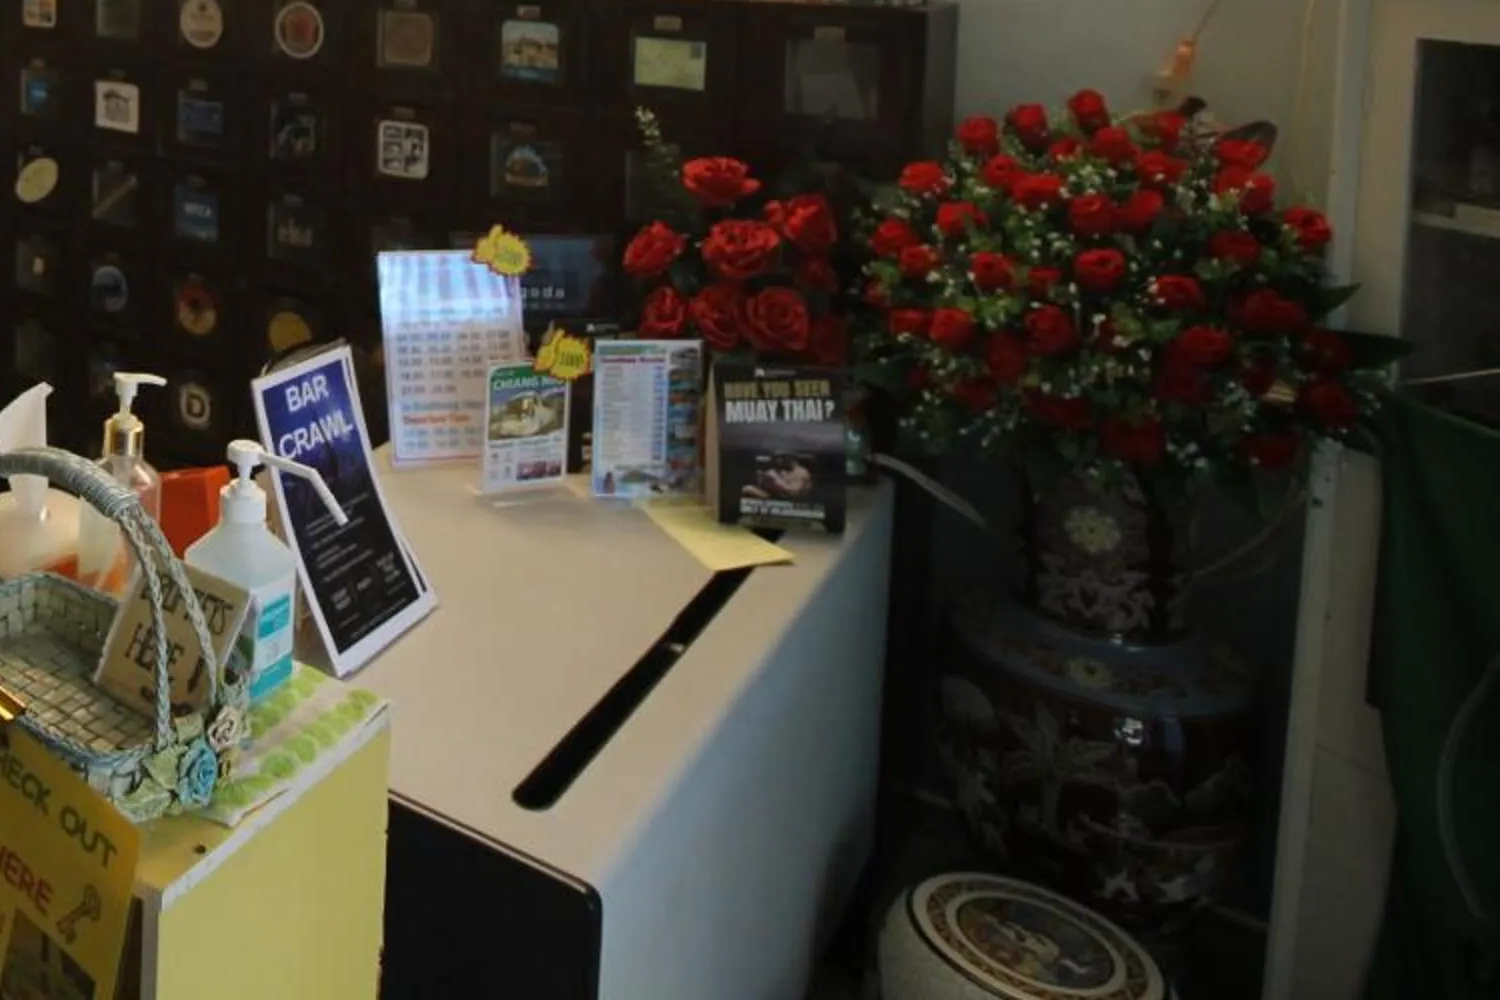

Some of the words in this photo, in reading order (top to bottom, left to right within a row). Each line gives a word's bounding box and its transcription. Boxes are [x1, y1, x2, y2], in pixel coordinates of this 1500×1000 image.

[520, 285, 565, 299] goda
[285, 374, 329, 412] BAR
[725, 399, 778, 423] MUAY
[781, 398, 836, 422] THAI?
[279, 411, 354, 459] CRAWL
[60, 805, 118, 871] OUT
